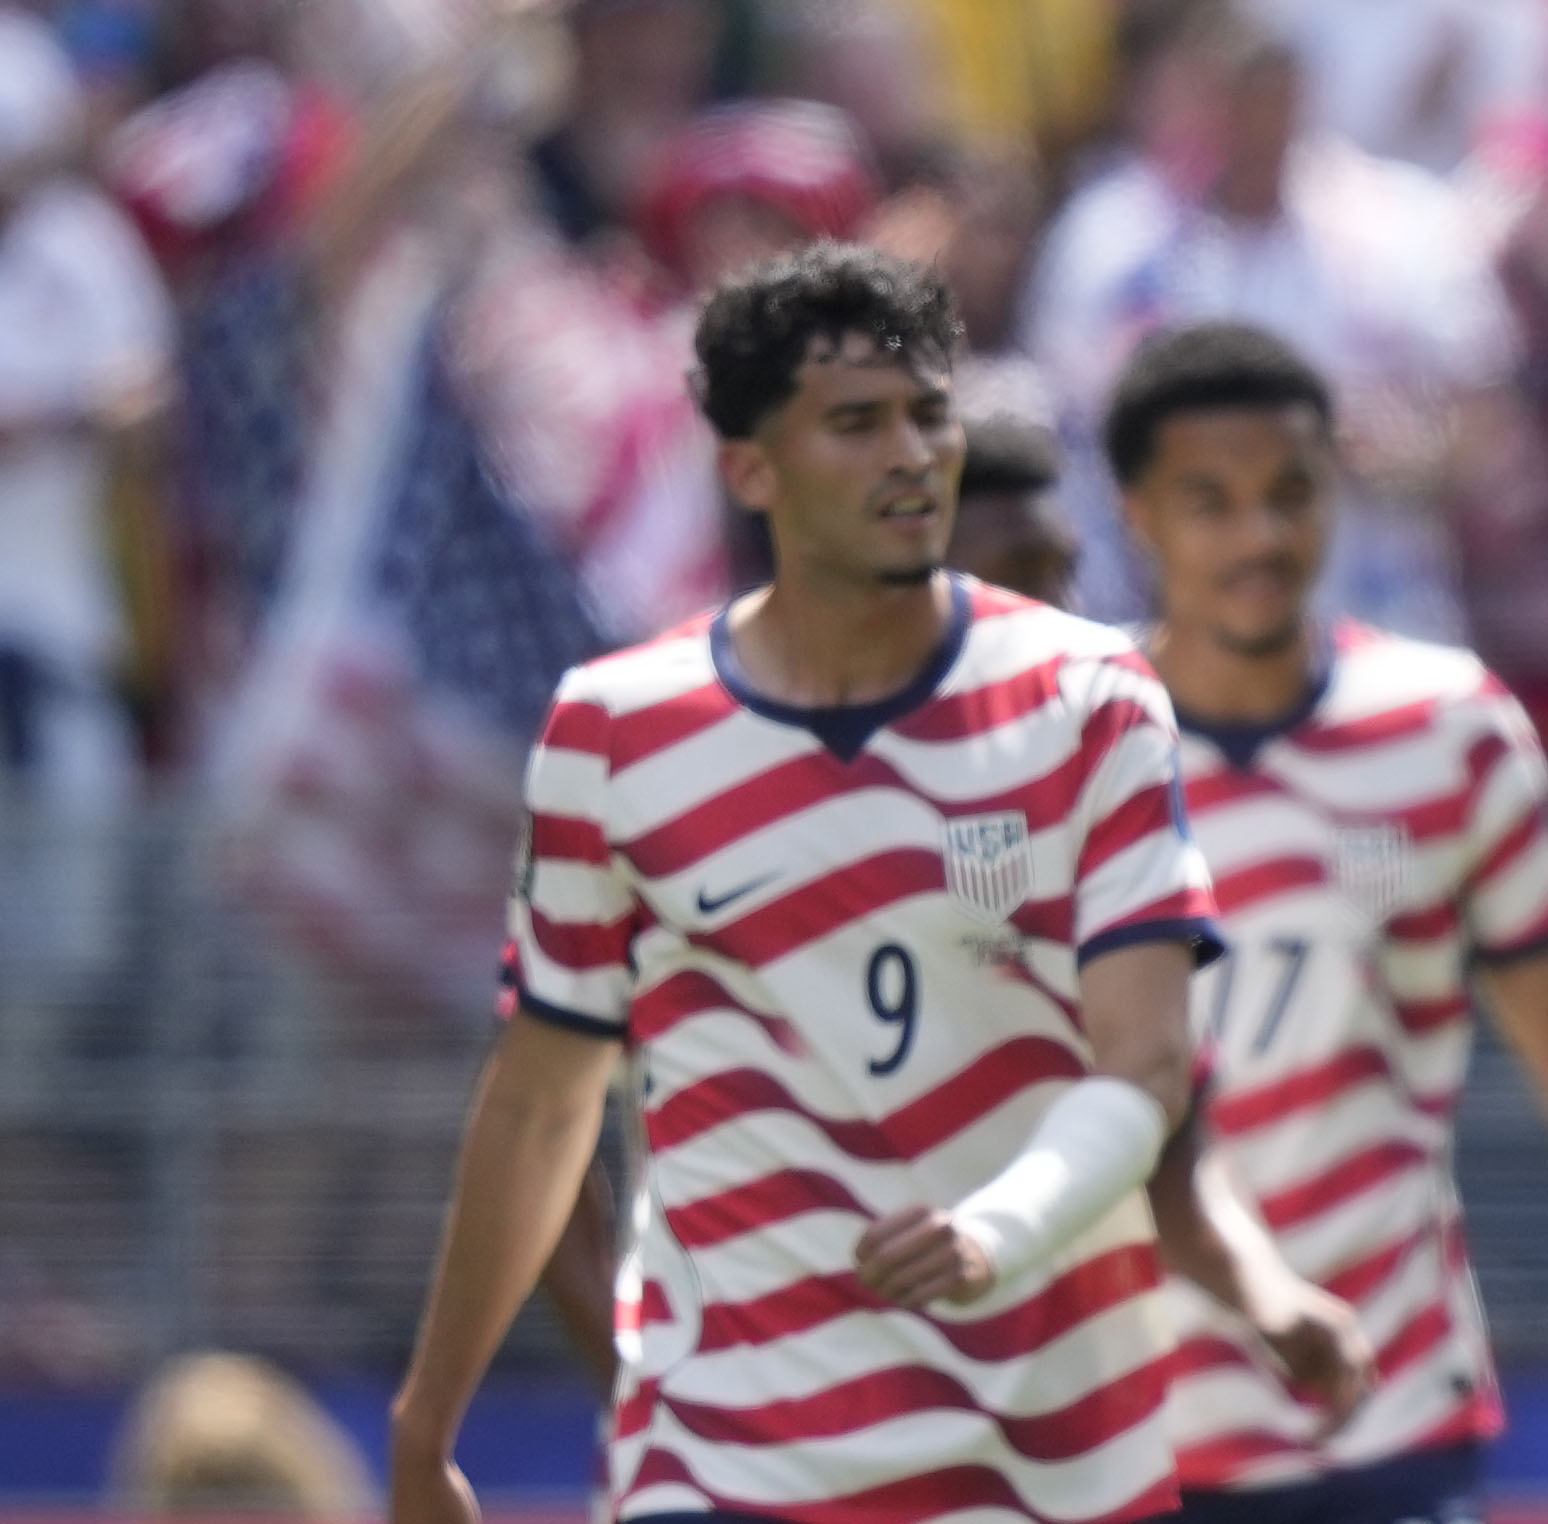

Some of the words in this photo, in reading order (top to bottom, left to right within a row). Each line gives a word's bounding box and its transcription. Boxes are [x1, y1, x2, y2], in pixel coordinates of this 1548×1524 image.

[947, 820, 1024, 863] USA
[865, 941, 919, 1076] 9
[1210, 937, 1311, 1058] 17
